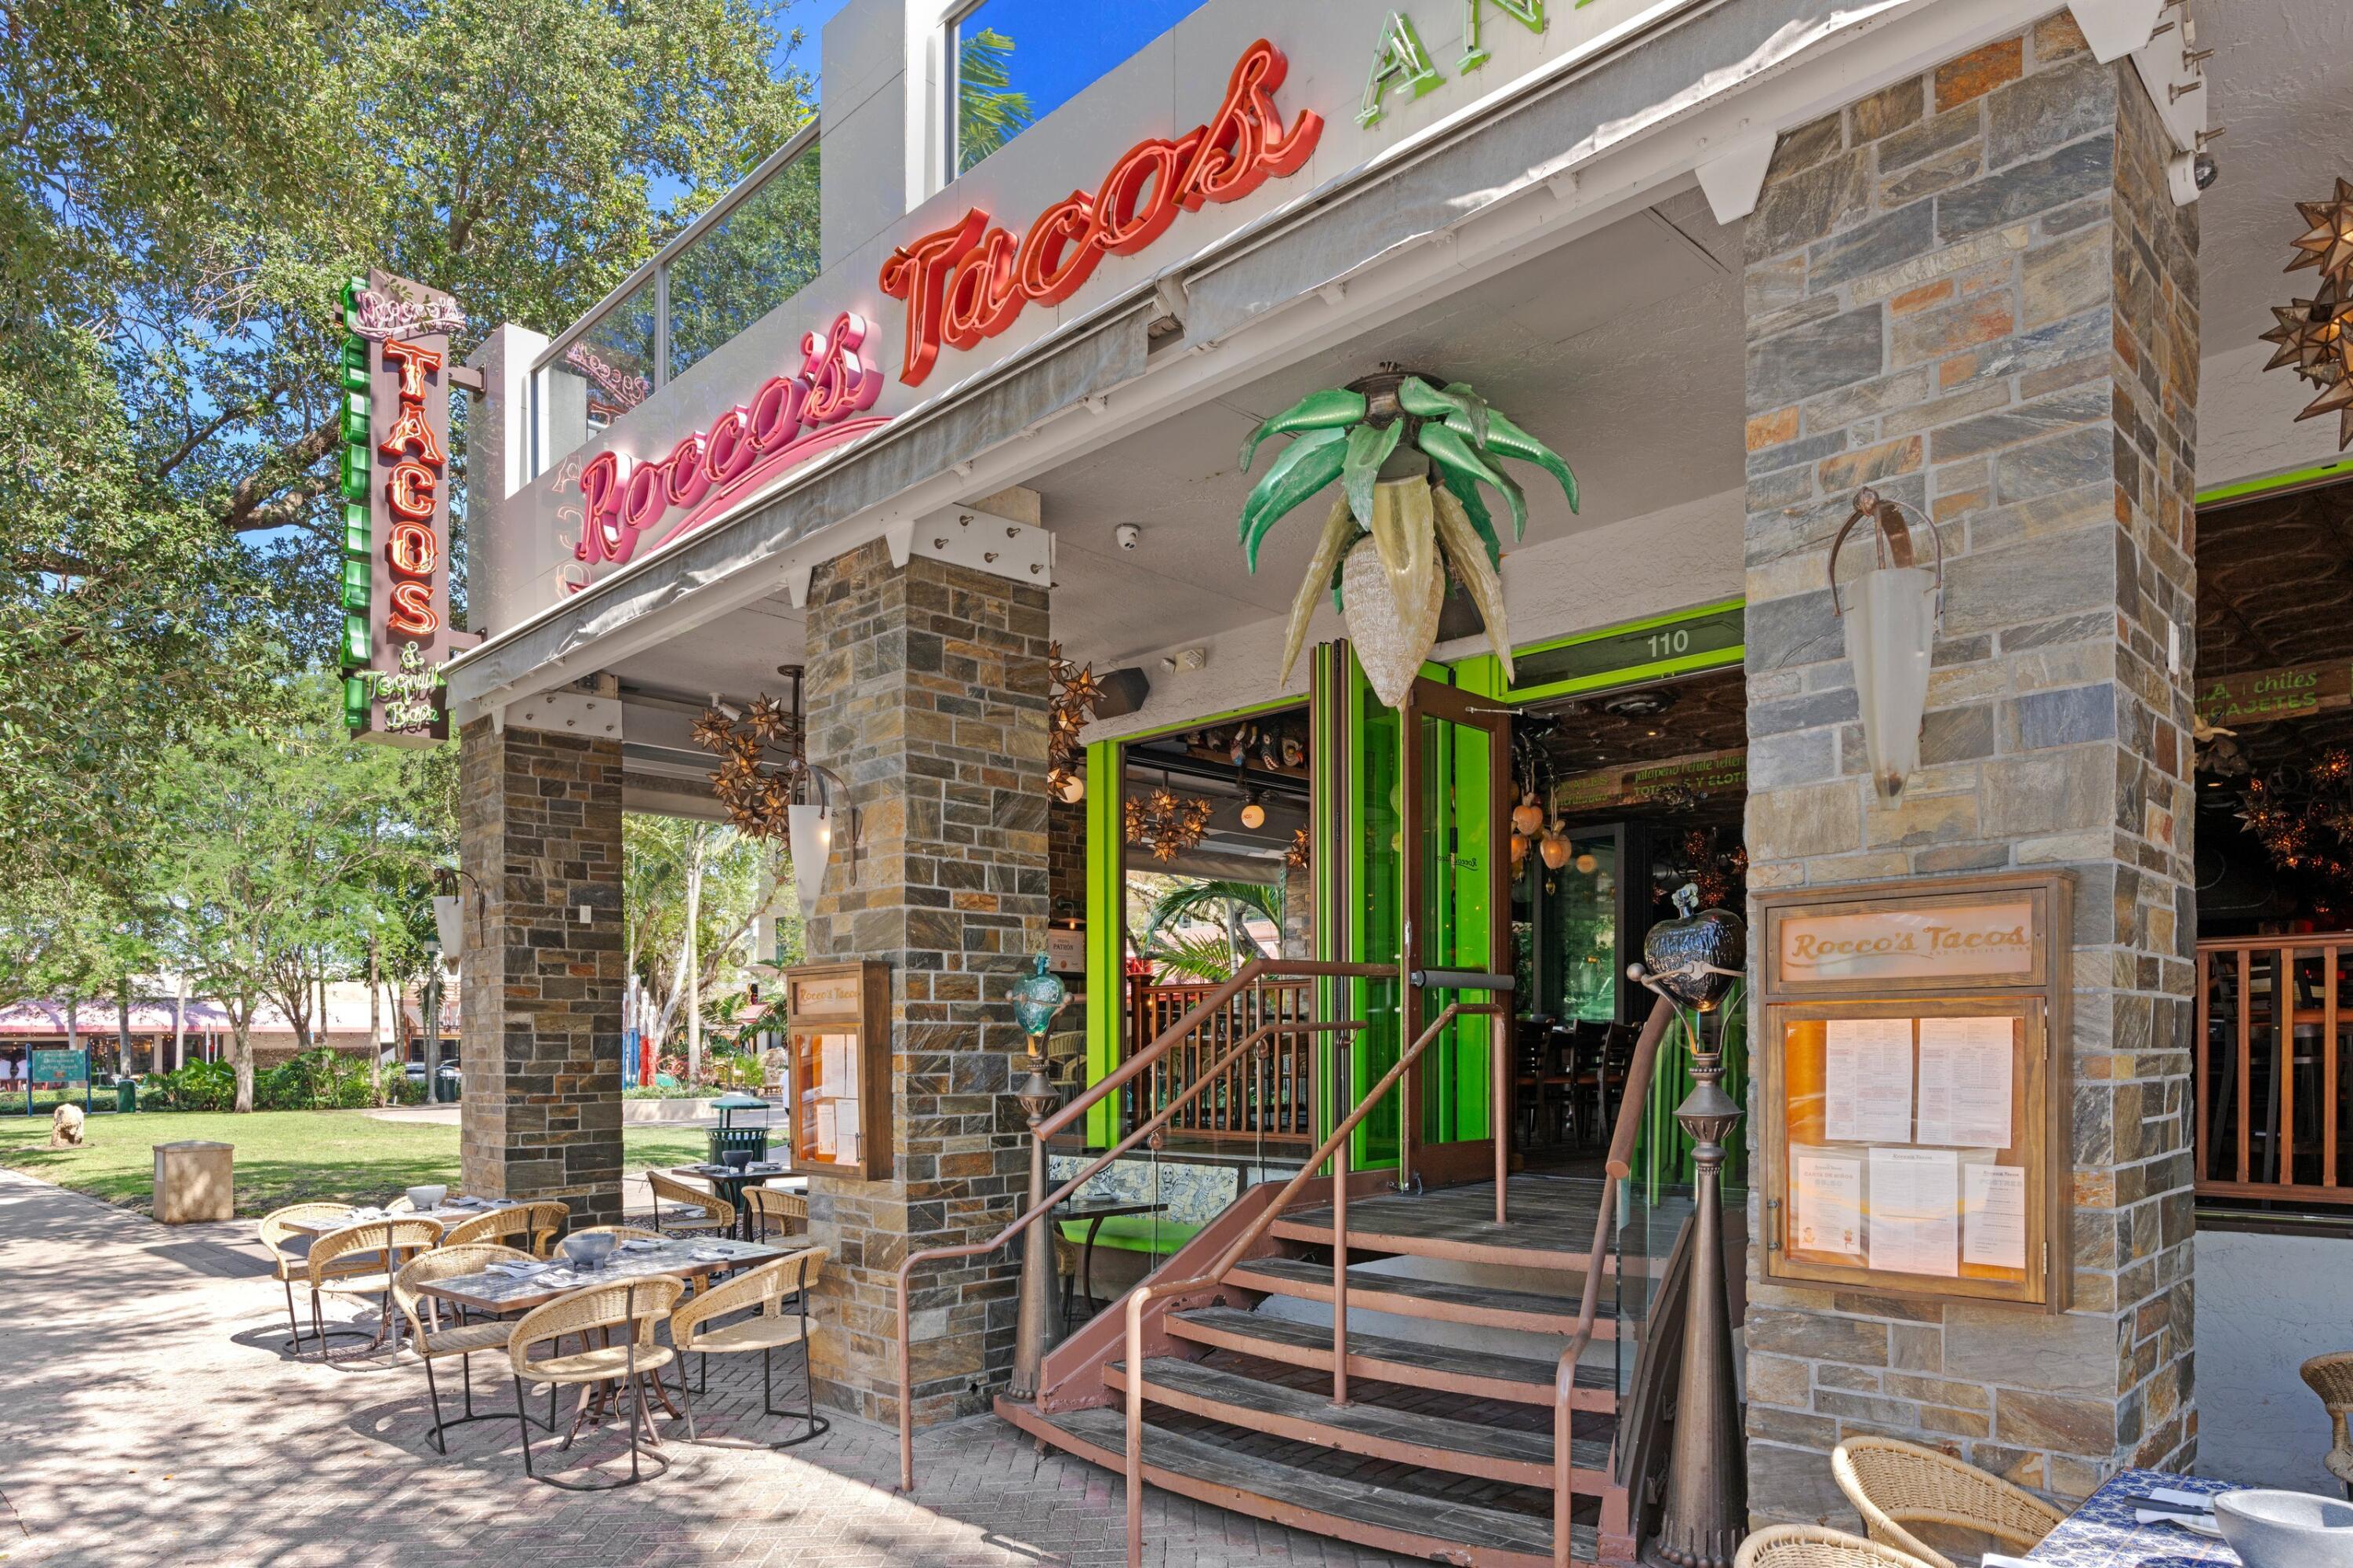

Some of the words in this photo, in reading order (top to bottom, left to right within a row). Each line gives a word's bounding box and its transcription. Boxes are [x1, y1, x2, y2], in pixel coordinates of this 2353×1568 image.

[573, 311, 885, 565] Rocco's
[878, 38, 1324, 388] Tacos
[379, 338, 447, 636] TACOS
[401, 641, 425, 669] &
[1648, 629, 1689, 657] 110
[355, 661, 447, 704] Tequil
[385, 702, 439, 728] Bar
[1791, 933, 1918, 960] Rocco's
[1922, 926, 2031, 951] Tacos
